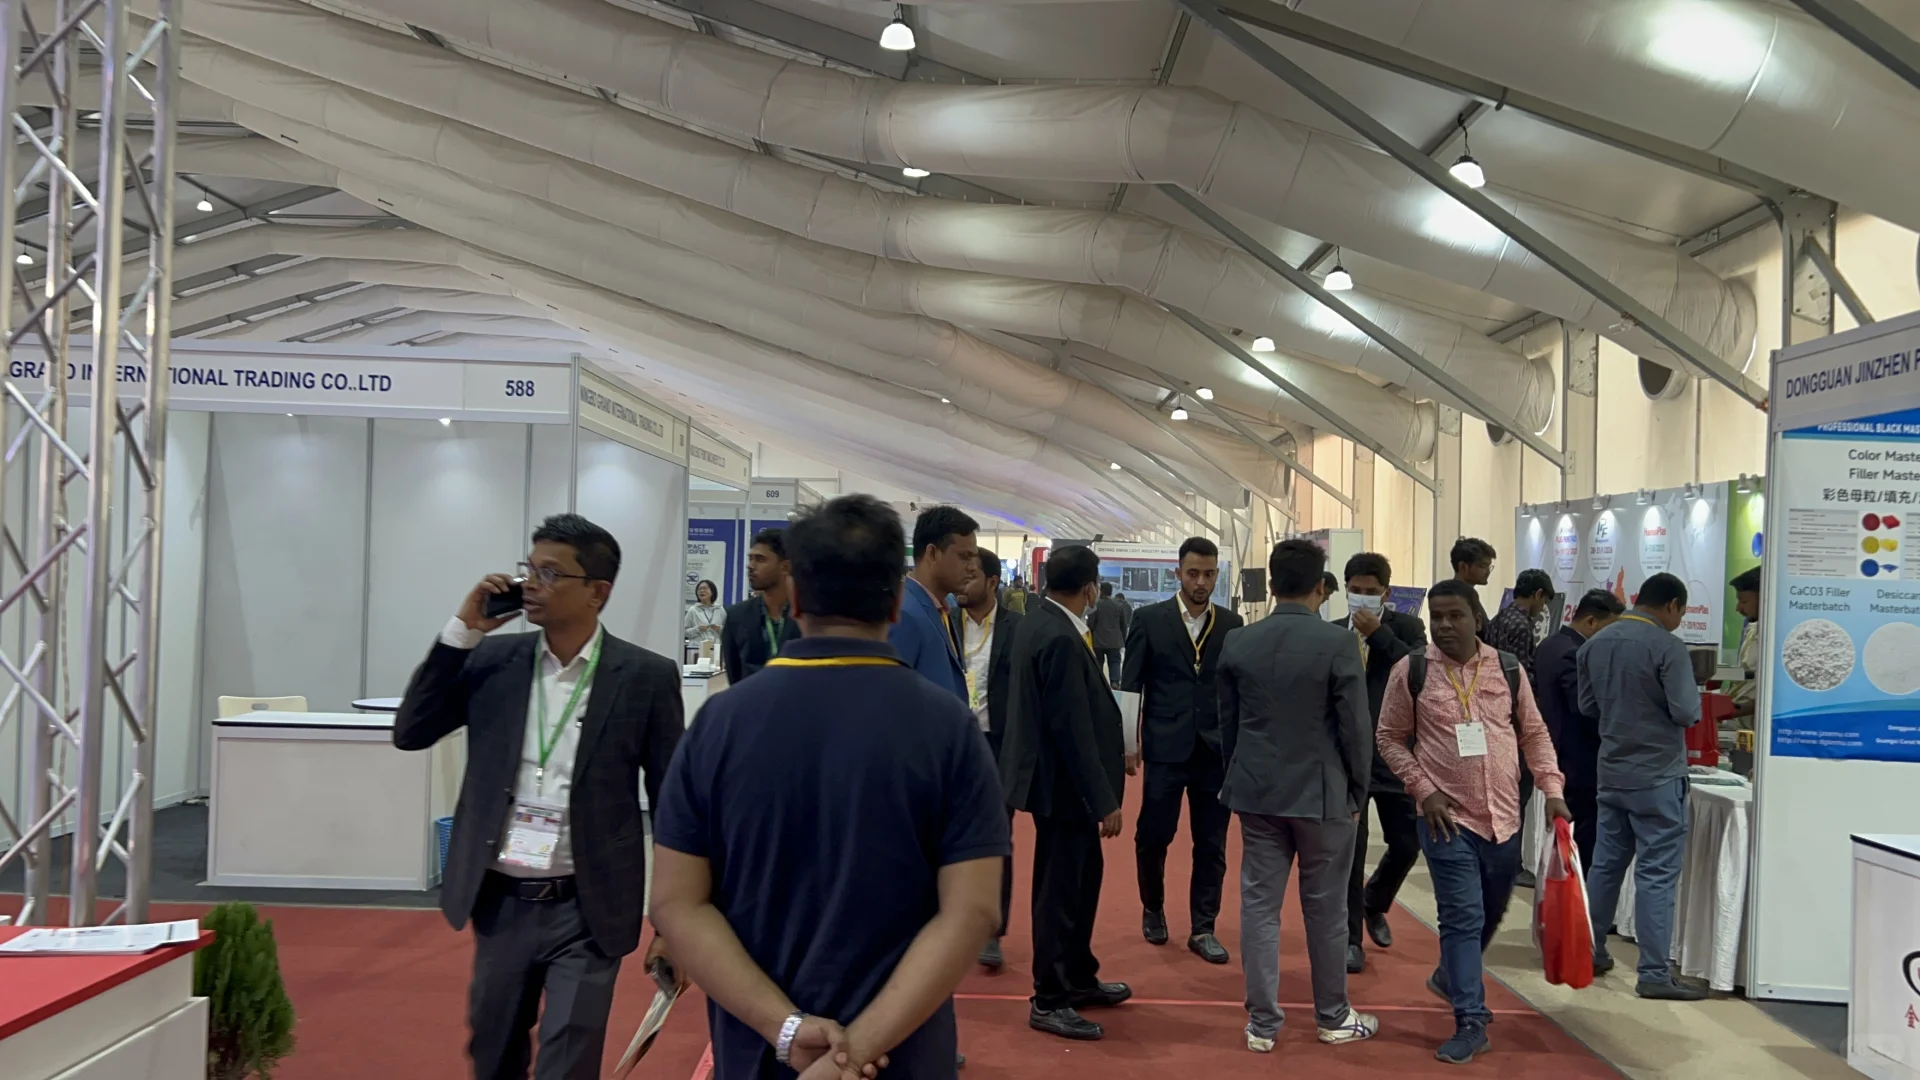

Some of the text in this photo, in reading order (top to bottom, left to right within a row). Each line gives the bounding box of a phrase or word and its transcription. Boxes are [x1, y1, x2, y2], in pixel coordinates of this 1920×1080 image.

[9, 360, 76, 380] GRAD
[233, 369, 315, 389] TRADING
[1786, 365, 1853, 399] DONGGUAN
[1855, 350, 1911, 384] JINZHEN
[505, 379, 535, 397] 588
[1876, 422, 1902, 433] BLACK
[1848, 449, 1882, 461] Color
[1849, 468, 1880, 480] Filler
[765, 490, 780, 498] 609
[1822, 487, 1920, 504] 彩色母粒/填充/
[1789, 586, 1850, 598] CaCO3 Filler
[1788, 600, 1851, 612] Masterbatch
